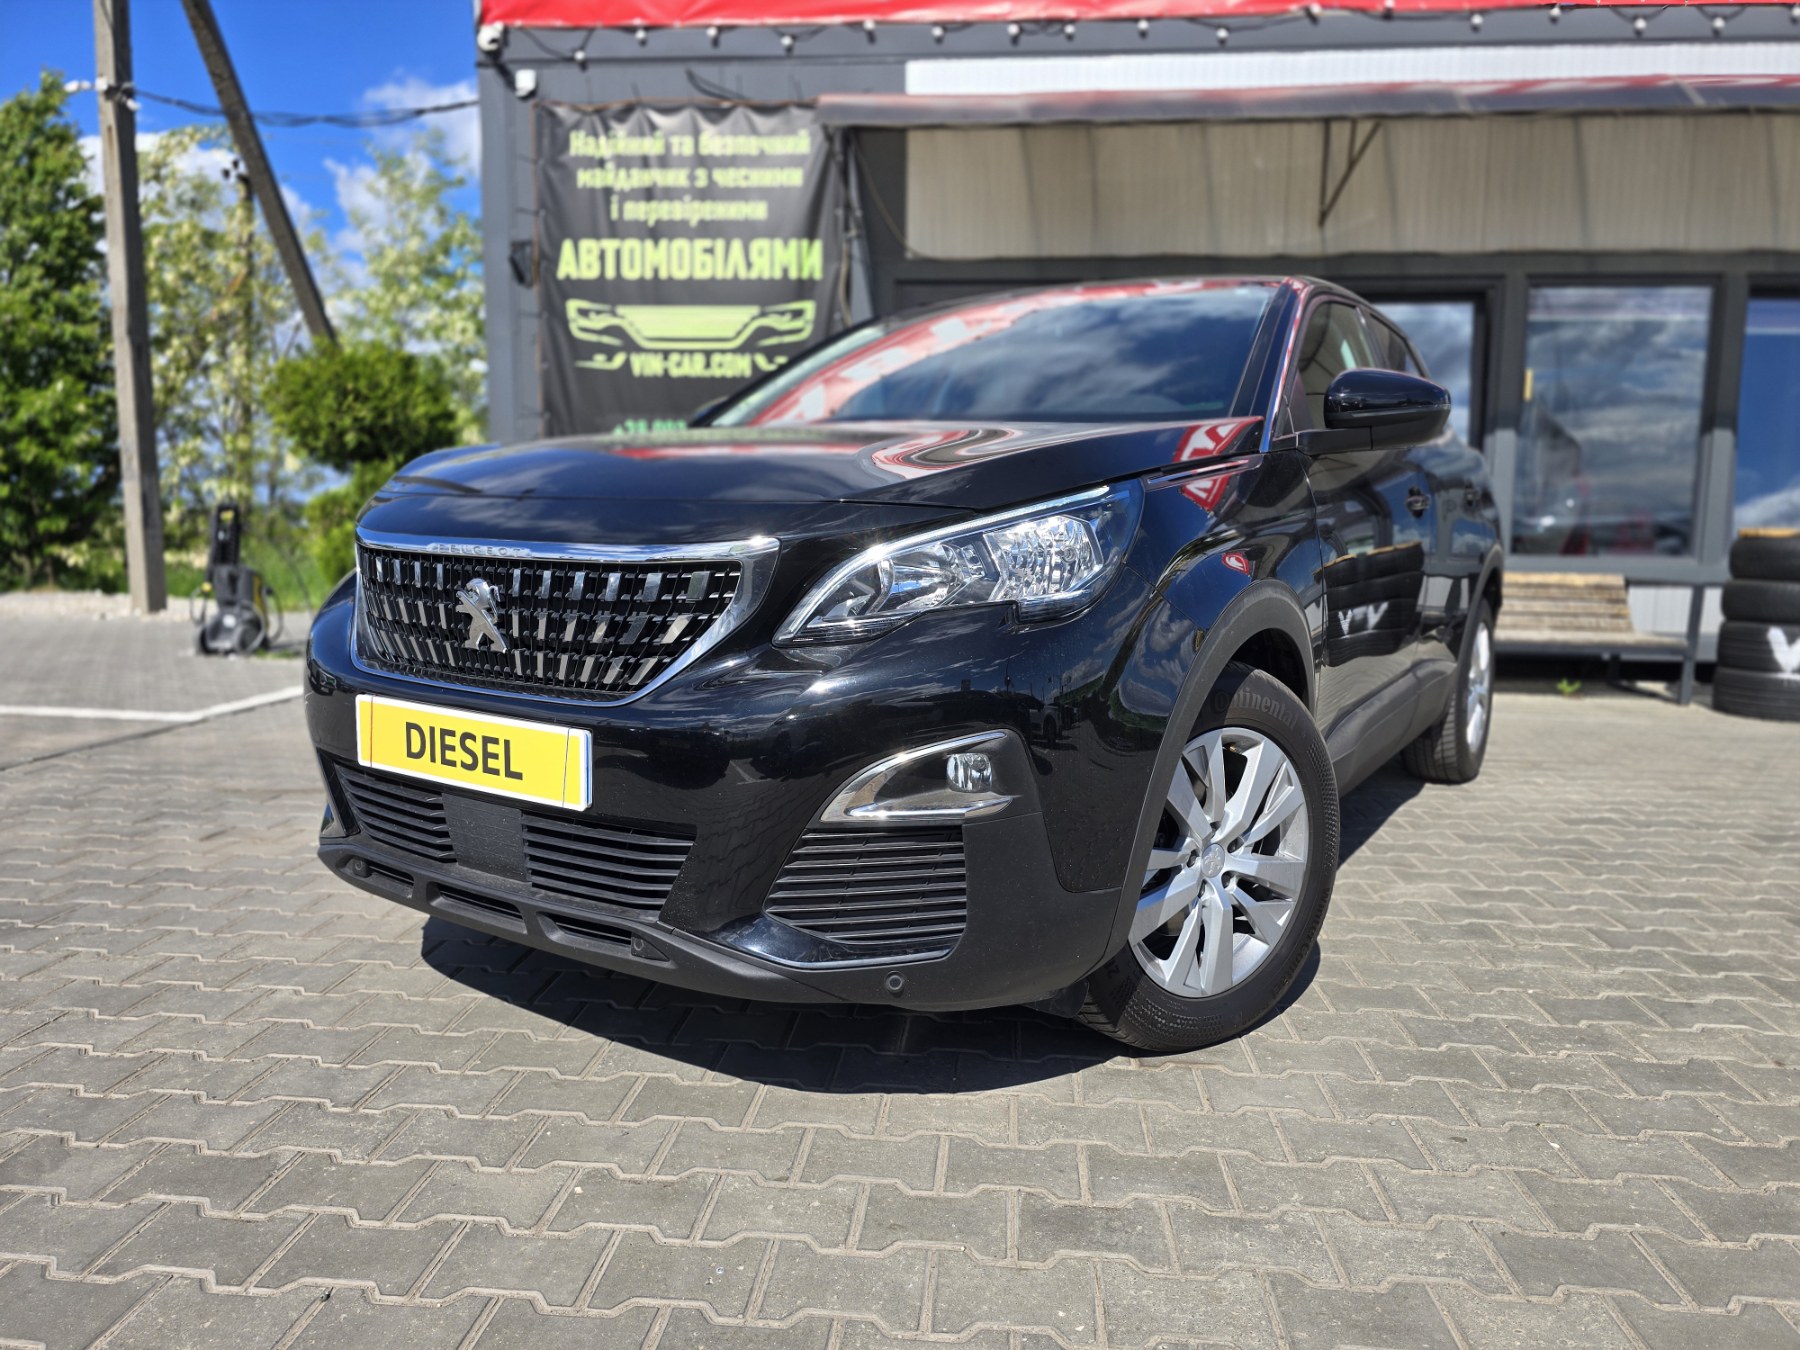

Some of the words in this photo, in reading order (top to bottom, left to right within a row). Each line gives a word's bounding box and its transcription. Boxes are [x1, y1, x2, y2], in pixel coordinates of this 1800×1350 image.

[570, 130, 665, 158] Надійний
[671, 135, 694, 156] та
[698, 130, 811, 155] безпечний
[577, 163, 689, 190] майданчик
[695, 167, 709, 188] з
[712, 167, 803, 187] чесними
[623, 195, 768, 226] перевіреними
[557, 237, 824, 281] АВТОМОБІЛЯМИ
[629, 352, 752, 378] VIN-CAR.COM
[436, 543, 521, 557] PEUGEOT
[1209, 687, 1299, 731] Continental
[405, 721, 523, 781] DIESEL
